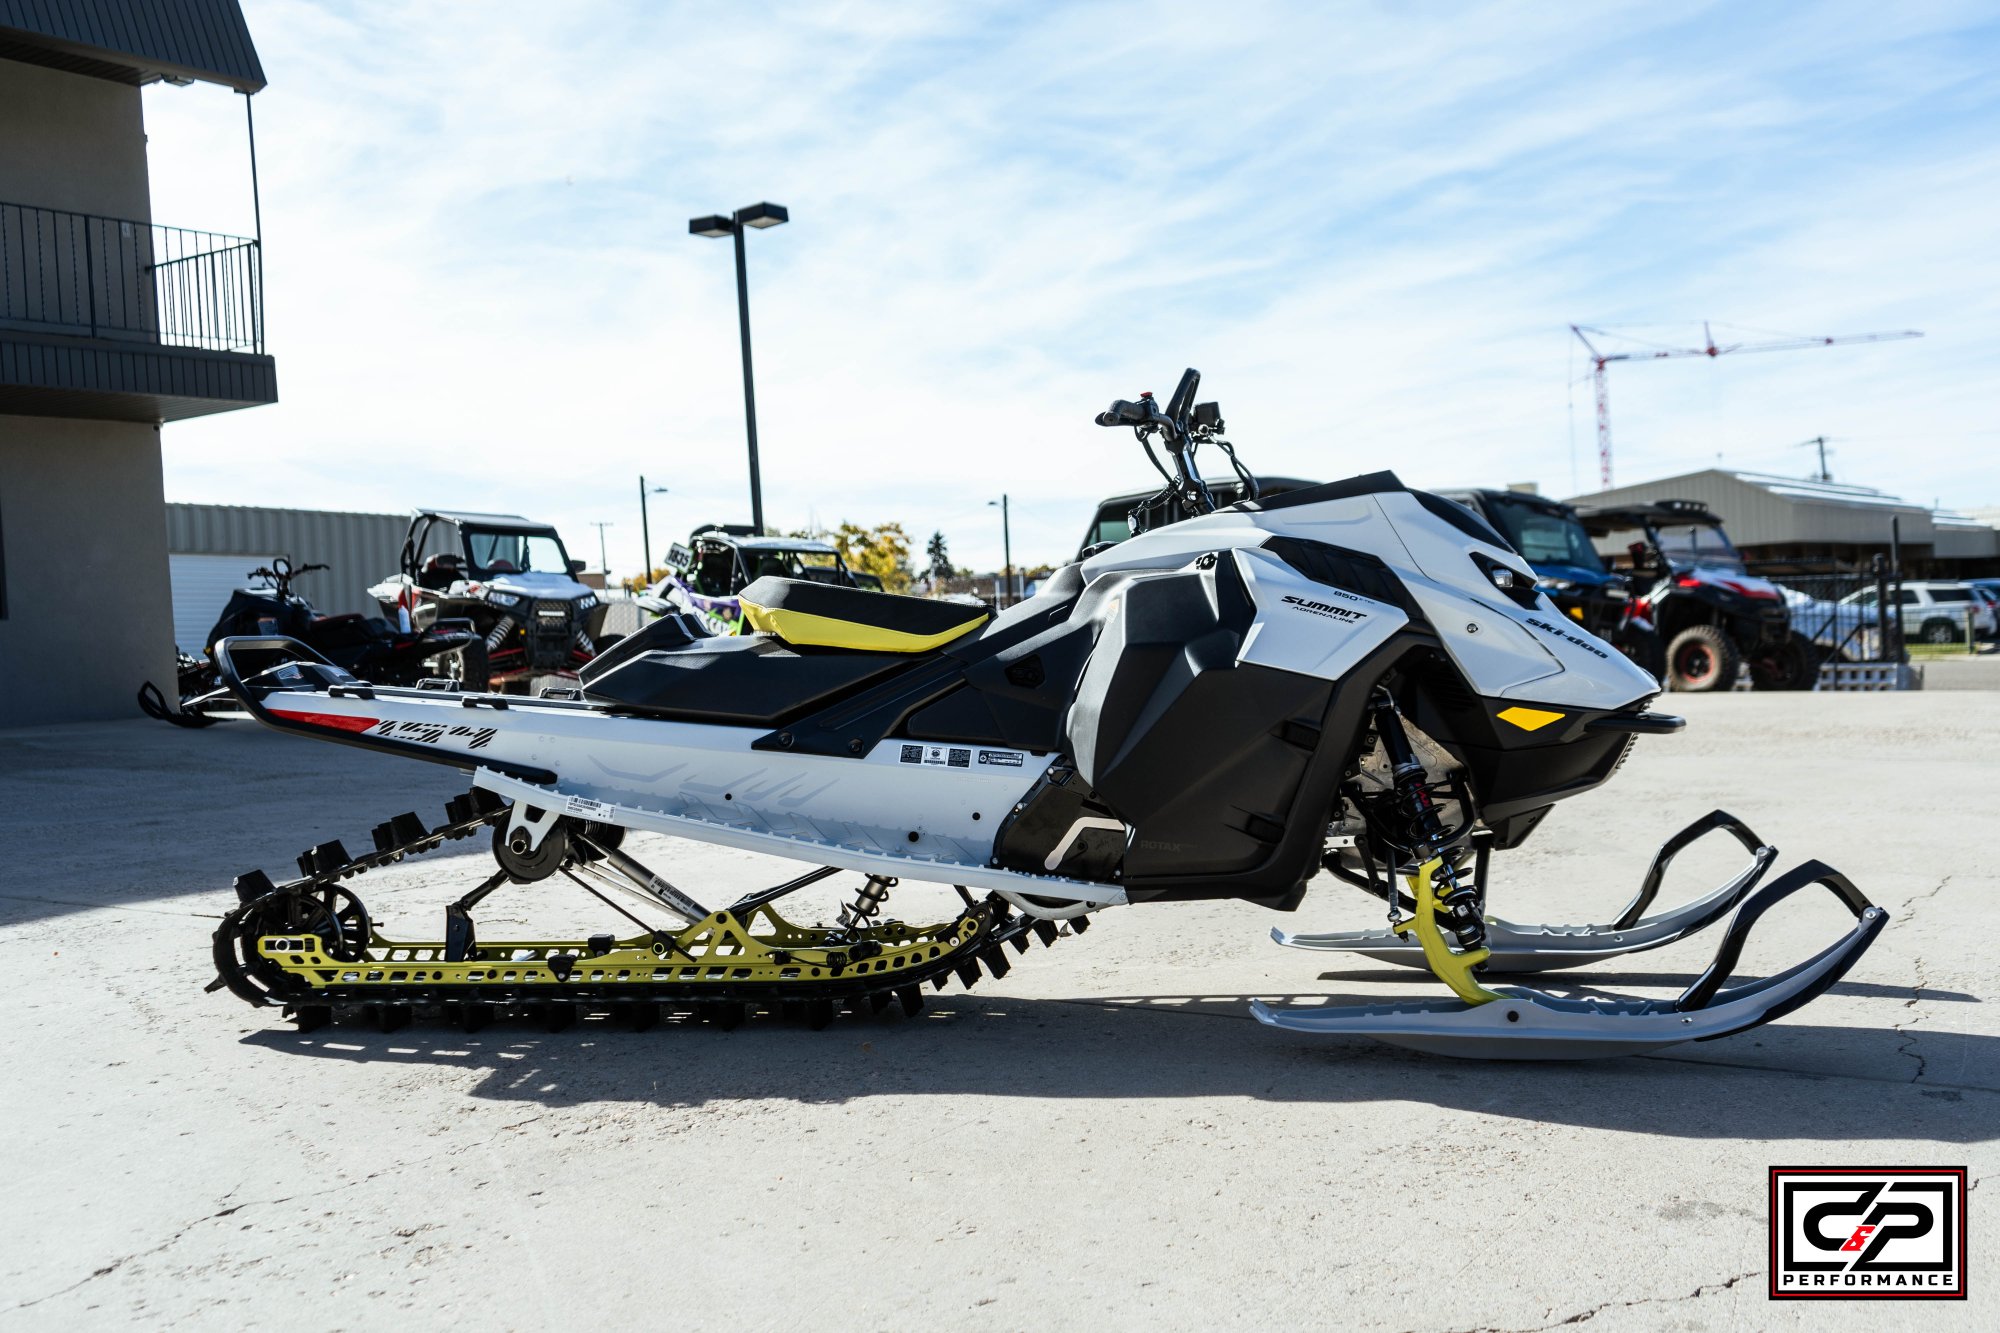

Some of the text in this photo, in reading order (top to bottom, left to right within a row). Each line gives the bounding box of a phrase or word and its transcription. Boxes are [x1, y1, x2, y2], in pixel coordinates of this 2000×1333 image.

[667, 549, 690, 567] 1835
[1333, 590, 1358, 602] 850
[1281, 595, 1367, 620] SUMMIT
[1292, 606, 1355, 624] ADRENALINE
[377, 719, 498, 749] 154
[1140, 839, 1181, 853] ROTAX
